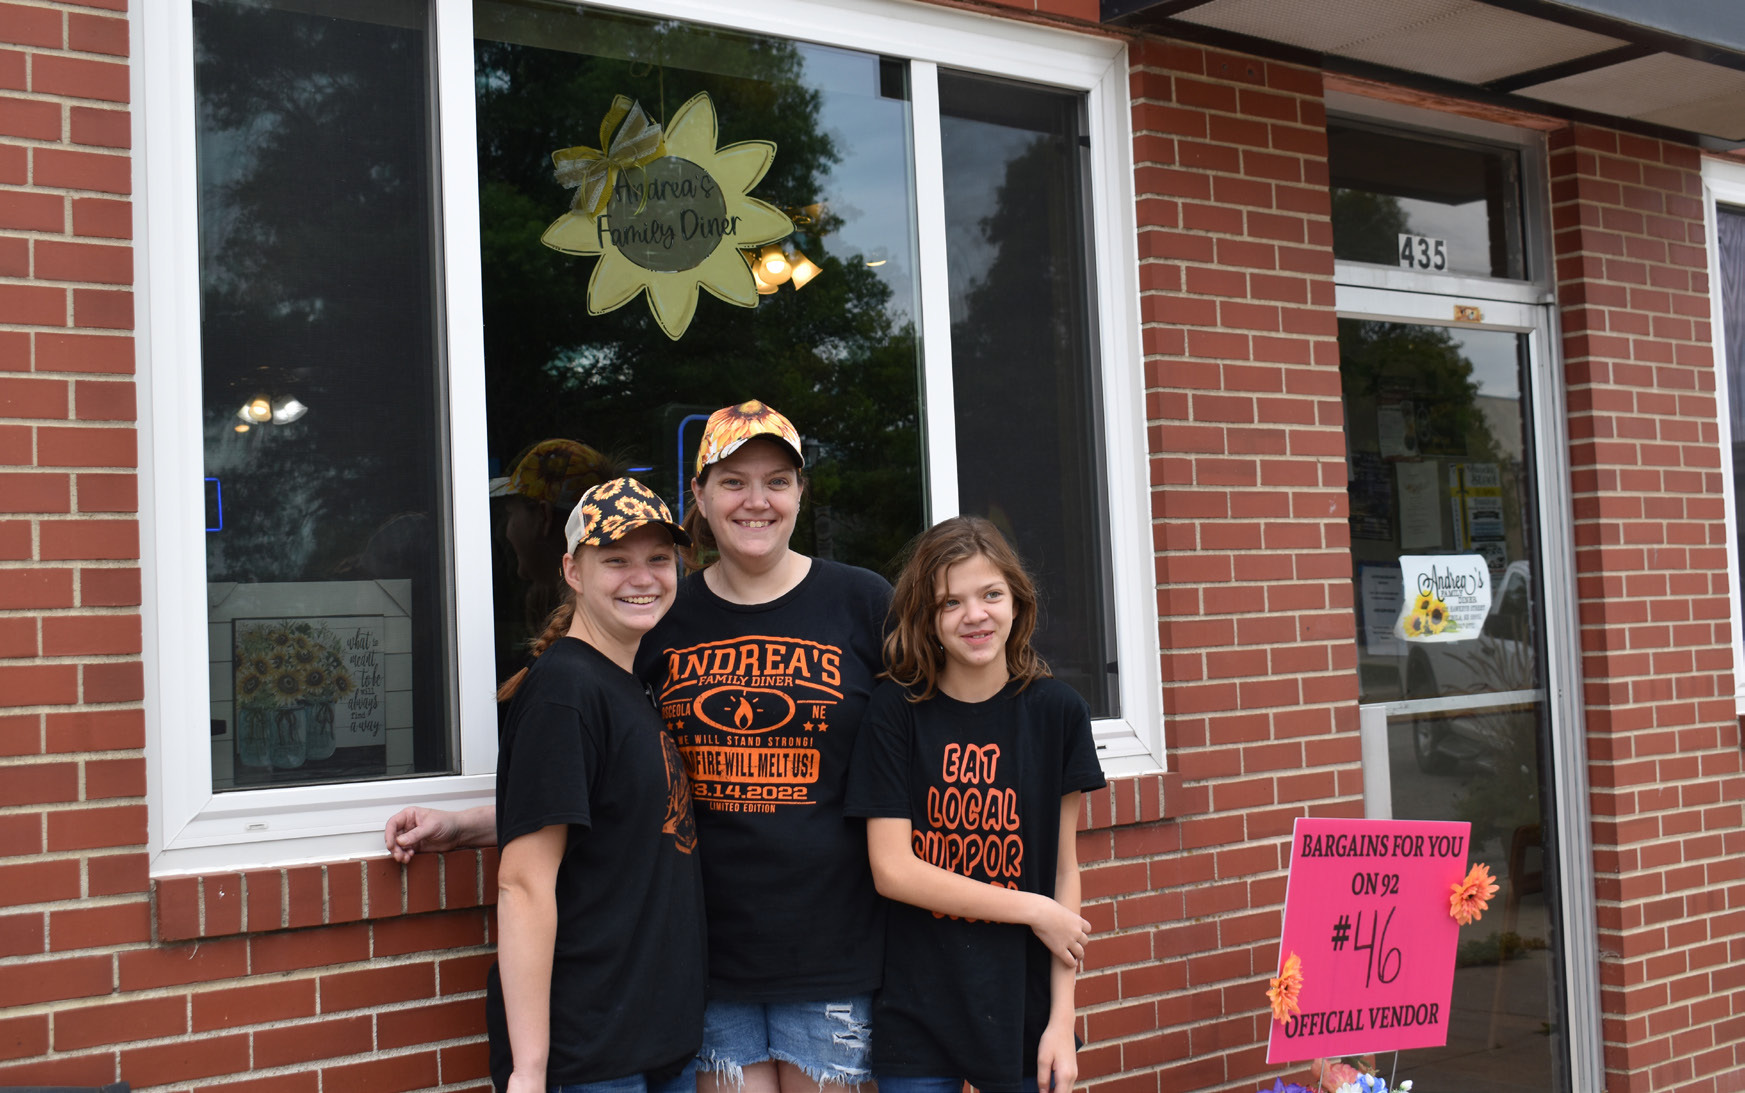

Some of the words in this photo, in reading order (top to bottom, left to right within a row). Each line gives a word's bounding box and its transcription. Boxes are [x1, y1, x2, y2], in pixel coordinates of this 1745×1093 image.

[613, 169, 714, 204] Andrea's
[597, 214, 675, 249] Family
[680, 209, 742, 241] Diner
[1401, 236, 1446, 271] 435
[1417, 564, 1484, 602] Andrea's
[662, 643, 841, 689] ANDREA'S
[698, 675, 749, 687] FAMILY
[751, 676, 794, 687] DINER
[812, 705, 826, 719] NE
[694, 734, 720, 745] WILL
[727, 735, 761, 747] STAND
[768, 737, 814, 747] STRONG!
[697, 751, 722, 776] FIRE
[724, 752, 755, 777] WILL
[758, 753, 790, 778] MELT
[792, 753, 814, 778] US!
[942, 743, 1000, 784] EAT
[710, 802, 740, 812] LIMITED
[743, 803, 776, 813] EDITION
[927, 786, 1020, 831] LOCAL
[1301, 834, 1389, 857] BARGAINS
[1392, 835, 1424, 857] FOR
[1428, 836, 1464, 857] YOU
[1352, 872, 1379, 895] ON
[1381, 874, 1400, 897] 92
[1331, 906, 1401, 988] #46
[1285, 1008, 1364, 1038] OFFICIAL
[1369, 1003, 1439, 1033] VENDOR
